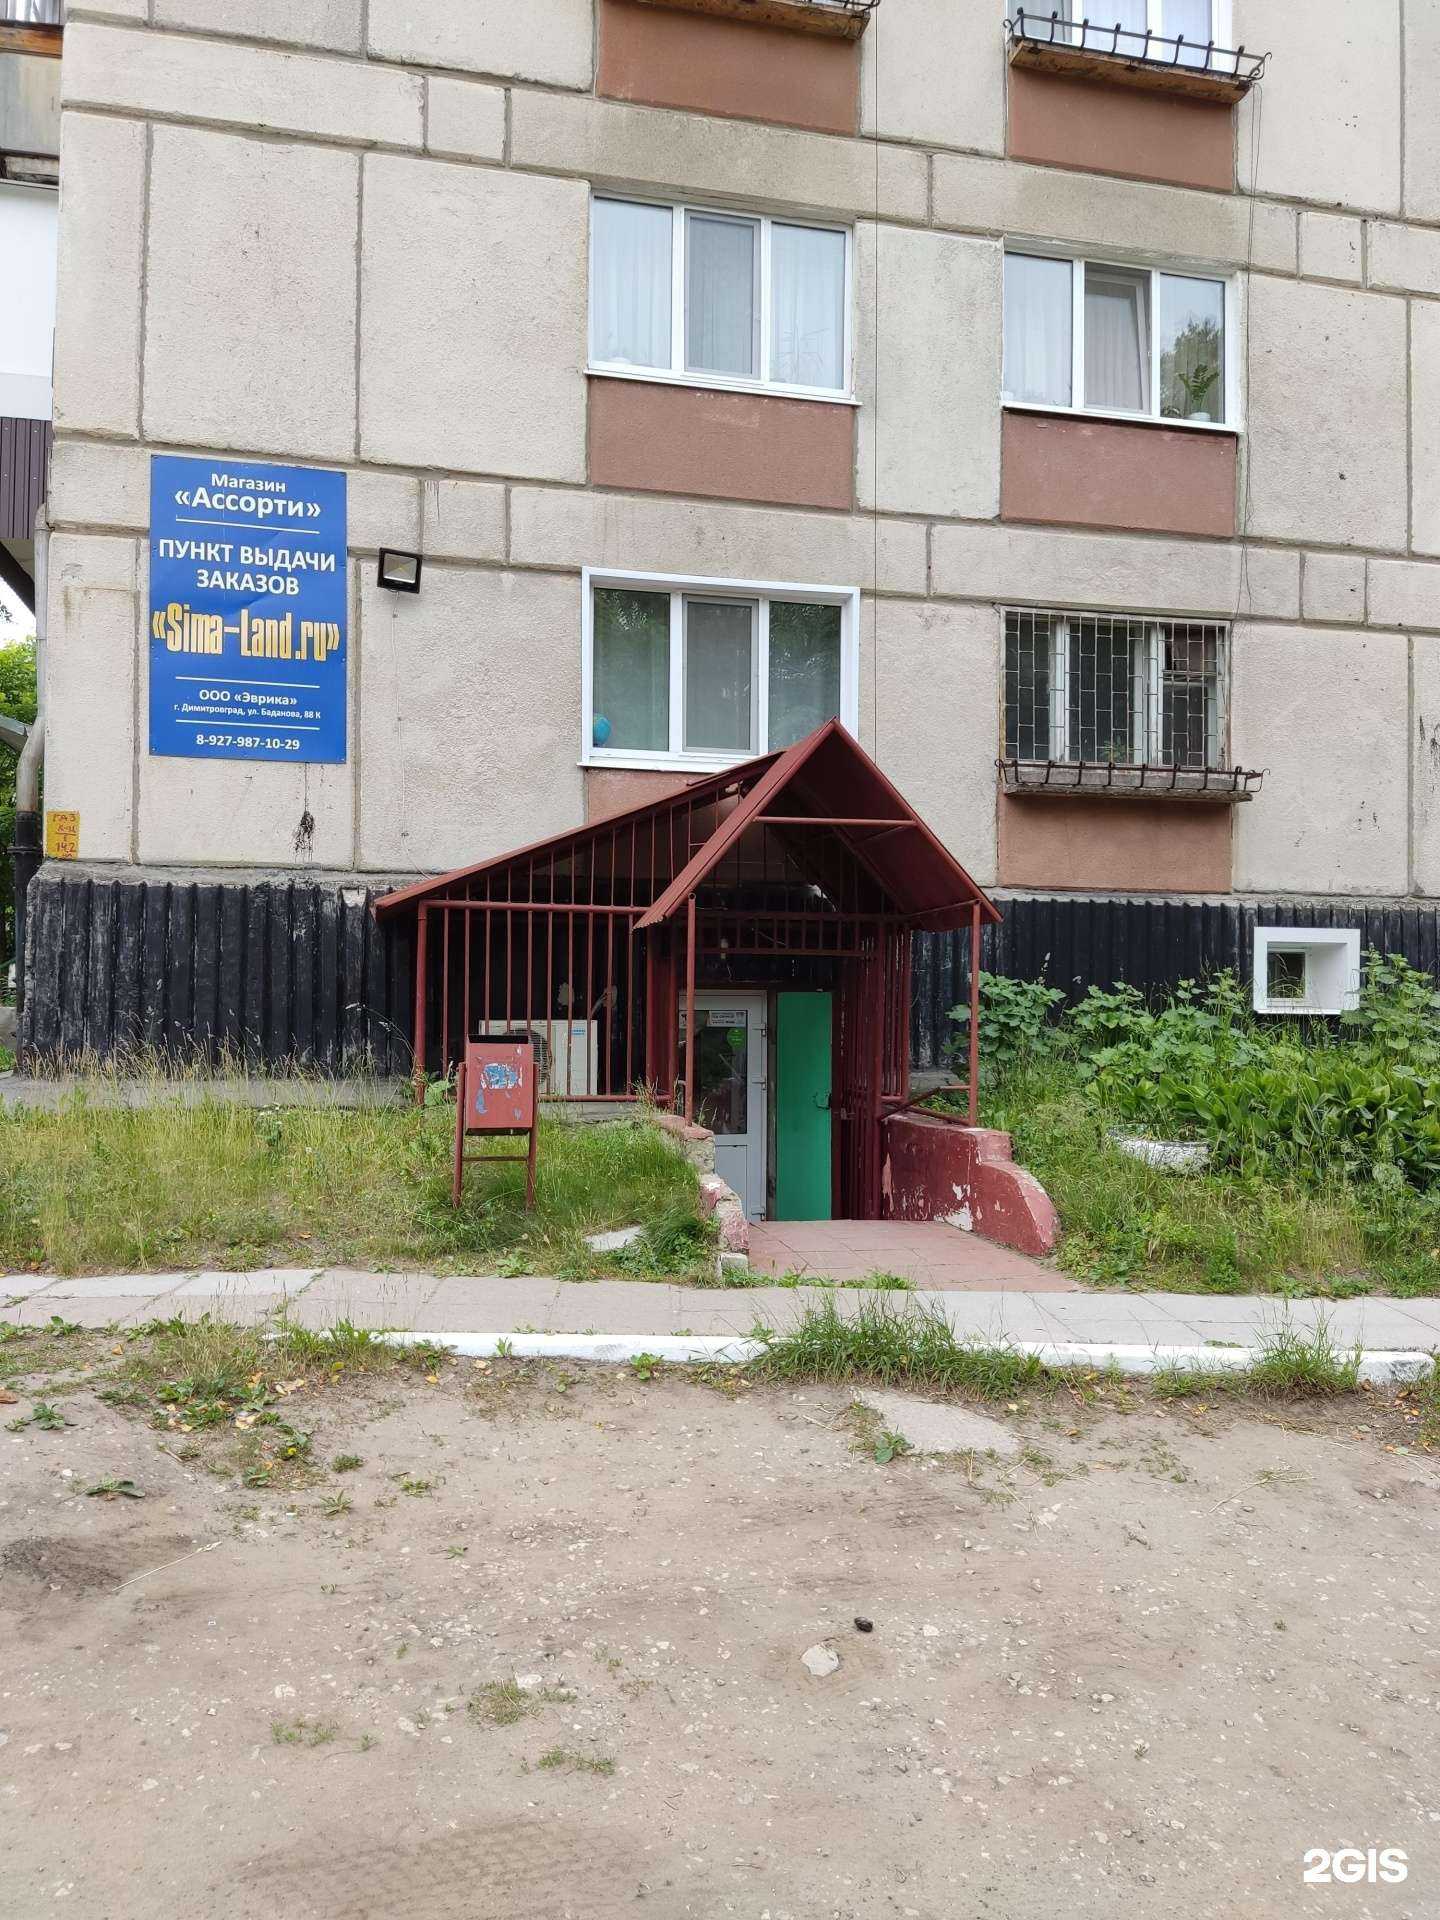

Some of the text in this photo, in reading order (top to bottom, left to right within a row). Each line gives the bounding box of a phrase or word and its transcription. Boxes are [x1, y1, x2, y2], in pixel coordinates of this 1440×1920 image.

[211, 473, 286, 493] Магазин
[174, 487, 321, 518] «Ассорти»
[159, 538, 336, 572] ПУНКТ ВЫДАЧИ
[196, 569, 299, 595] ЗАКАЗОВ
[152, 602, 340, 662] «Sima-Land.ru»
[199, 689, 297, 706] ООО «Эврика»
[181, 703, 246, 716] Димитровград,
[247, 708, 259, 716] ул.
[261, 708, 302, 719] Баданова,
[304, 710, 314, 719] 88
[196, 734, 300, 750] 8-927-987-10-29
